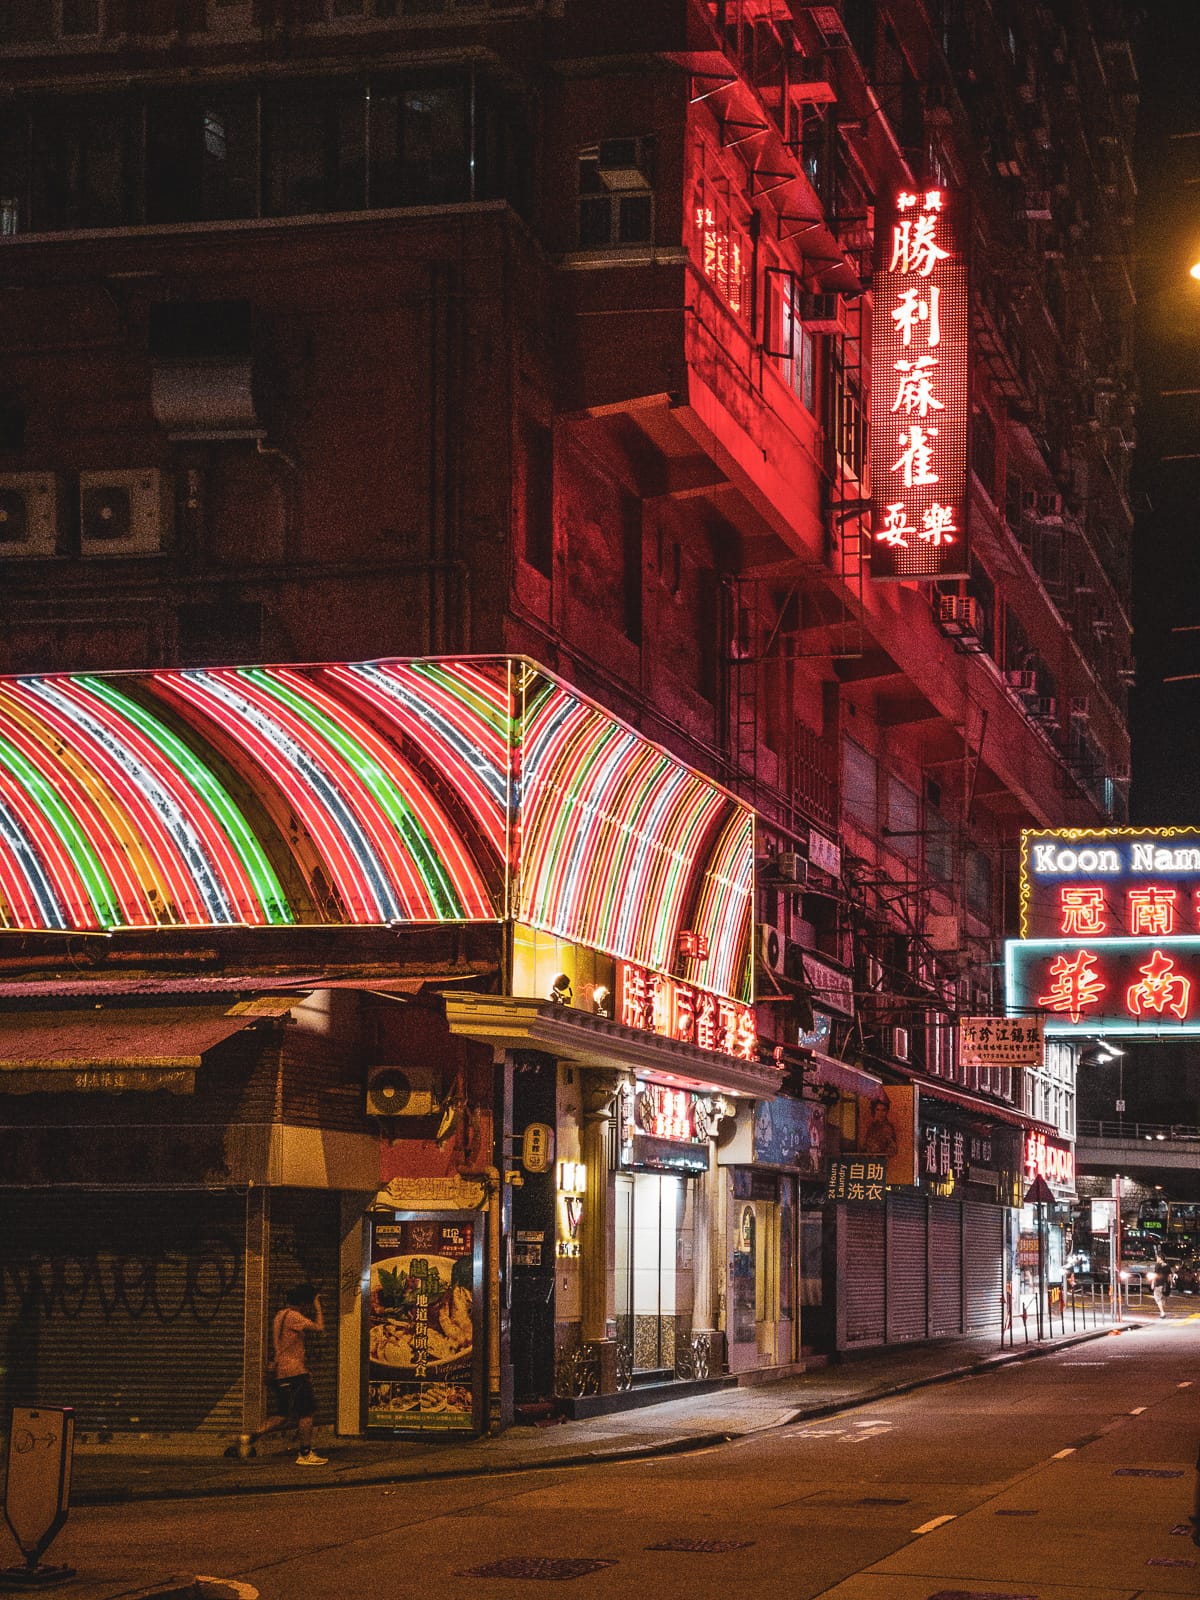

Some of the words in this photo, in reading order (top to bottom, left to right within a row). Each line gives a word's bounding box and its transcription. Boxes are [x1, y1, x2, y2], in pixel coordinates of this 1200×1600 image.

[875, 502, 958, 548] 耍樂
[1033, 844, 1120, 872] Koon
[1131, 843, 1200, 872] Nam
[1061, 887, 1200, 935] 冠南
[1038, 950, 1191, 1024] 華南
[828, 1162, 838, 1188] Hours
[837, 1163, 848, 1199] Laundry
[849, 1163, 884, 1181] 自助
[828, 1188, 837, 1199] 24
[847, 1183, 884, 1201] 洗衣
[415, 1294, 429, 1377] 地道街頭美食
